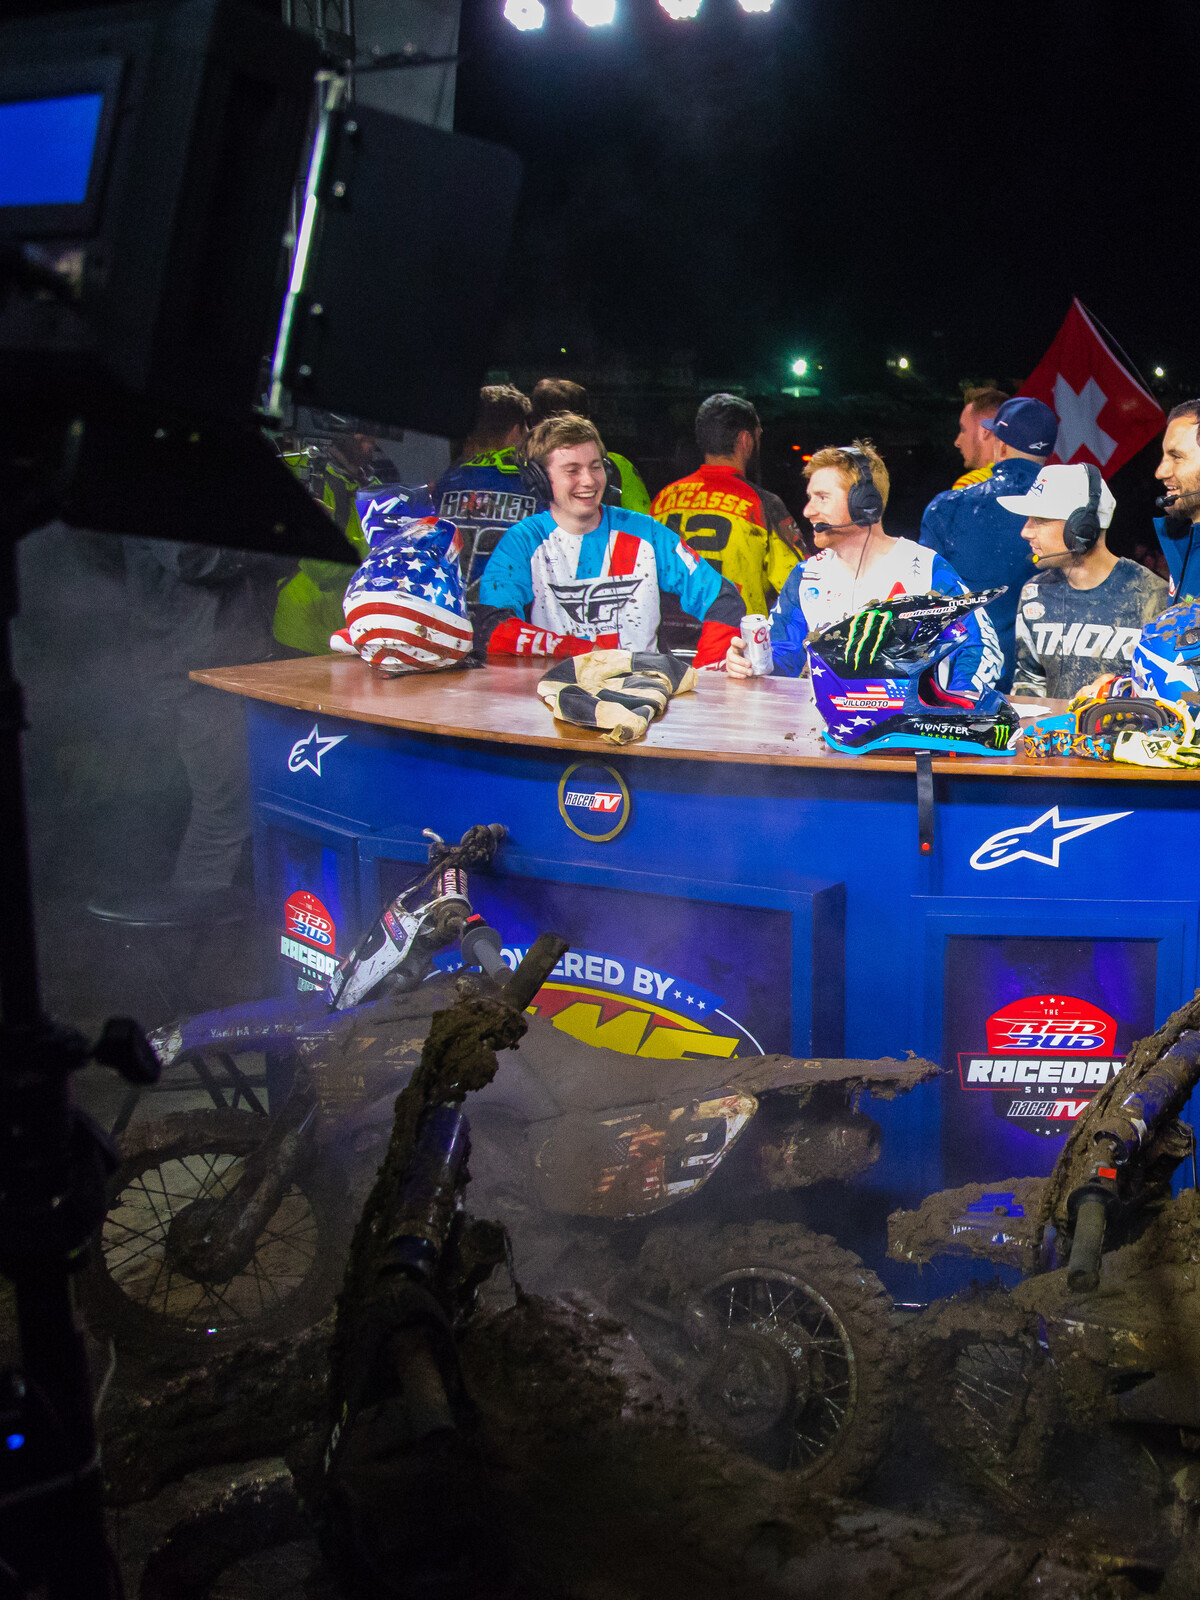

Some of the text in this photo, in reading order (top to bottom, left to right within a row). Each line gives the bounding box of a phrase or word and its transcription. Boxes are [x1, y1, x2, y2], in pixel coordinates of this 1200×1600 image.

[653, 491, 754, 516] LACASSE
[516, 628, 564, 655] FLY
[1033, 622, 1143, 660] THOR
[842, 699, 889, 708] VILLOPOTO
[914, 722, 970, 735] MONSTER
[632, 966, 675, 1001] BY
[1025, 1086, 1074, 1094] SHOW
